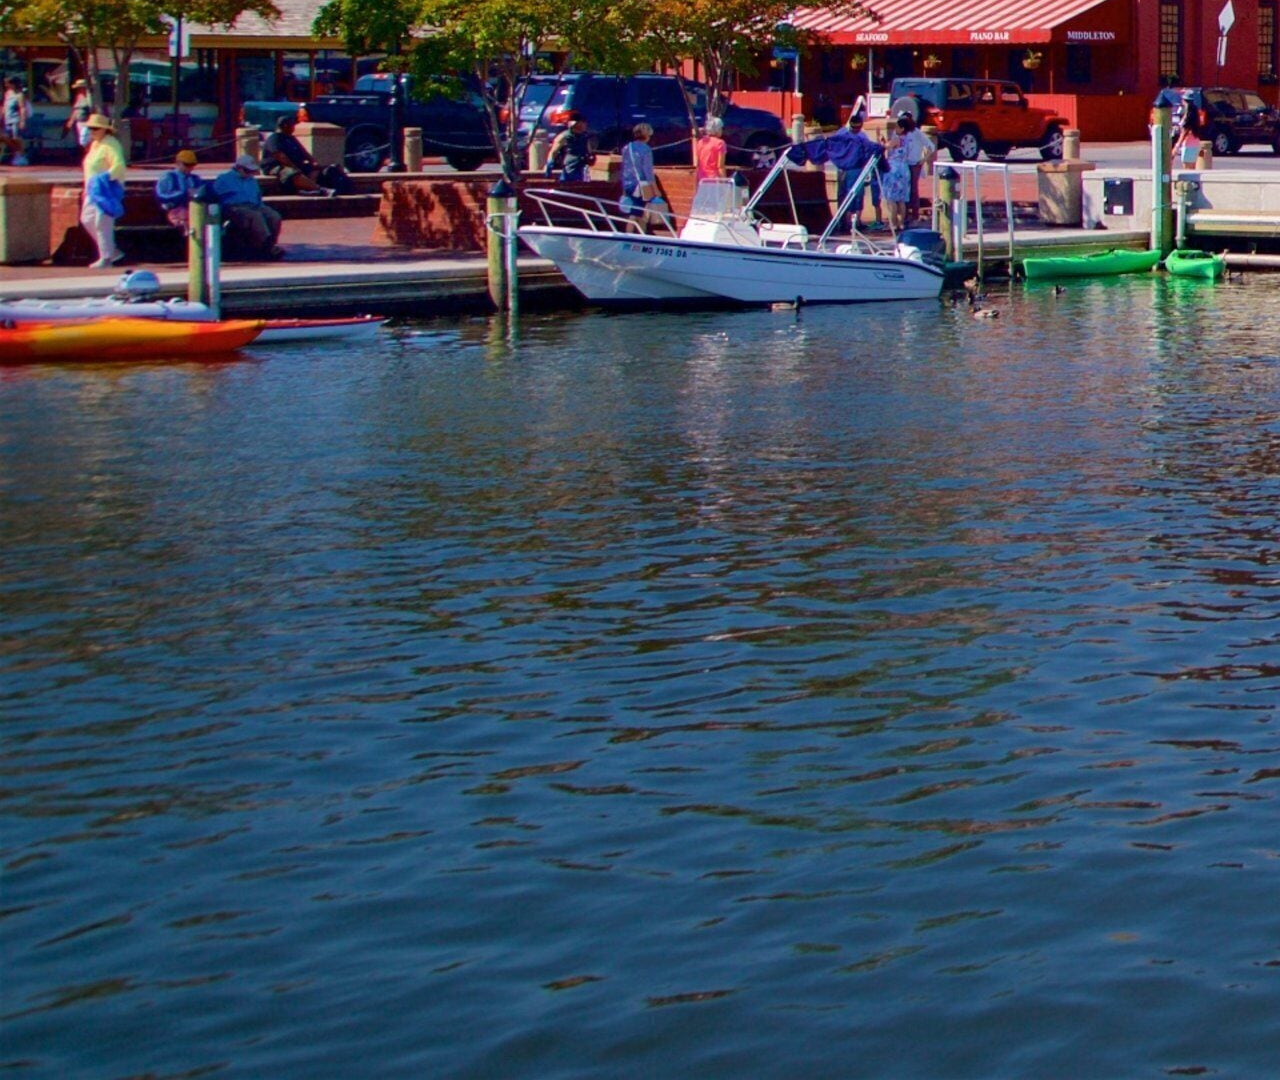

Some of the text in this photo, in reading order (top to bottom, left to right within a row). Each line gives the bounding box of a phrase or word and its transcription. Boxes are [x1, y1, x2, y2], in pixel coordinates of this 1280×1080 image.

[855, 33, 889, 42] SEAFOOD
[970, 31, 1010, 41] PIANO BAR
[1067, 30, 1116, 40] MIDDLETON
